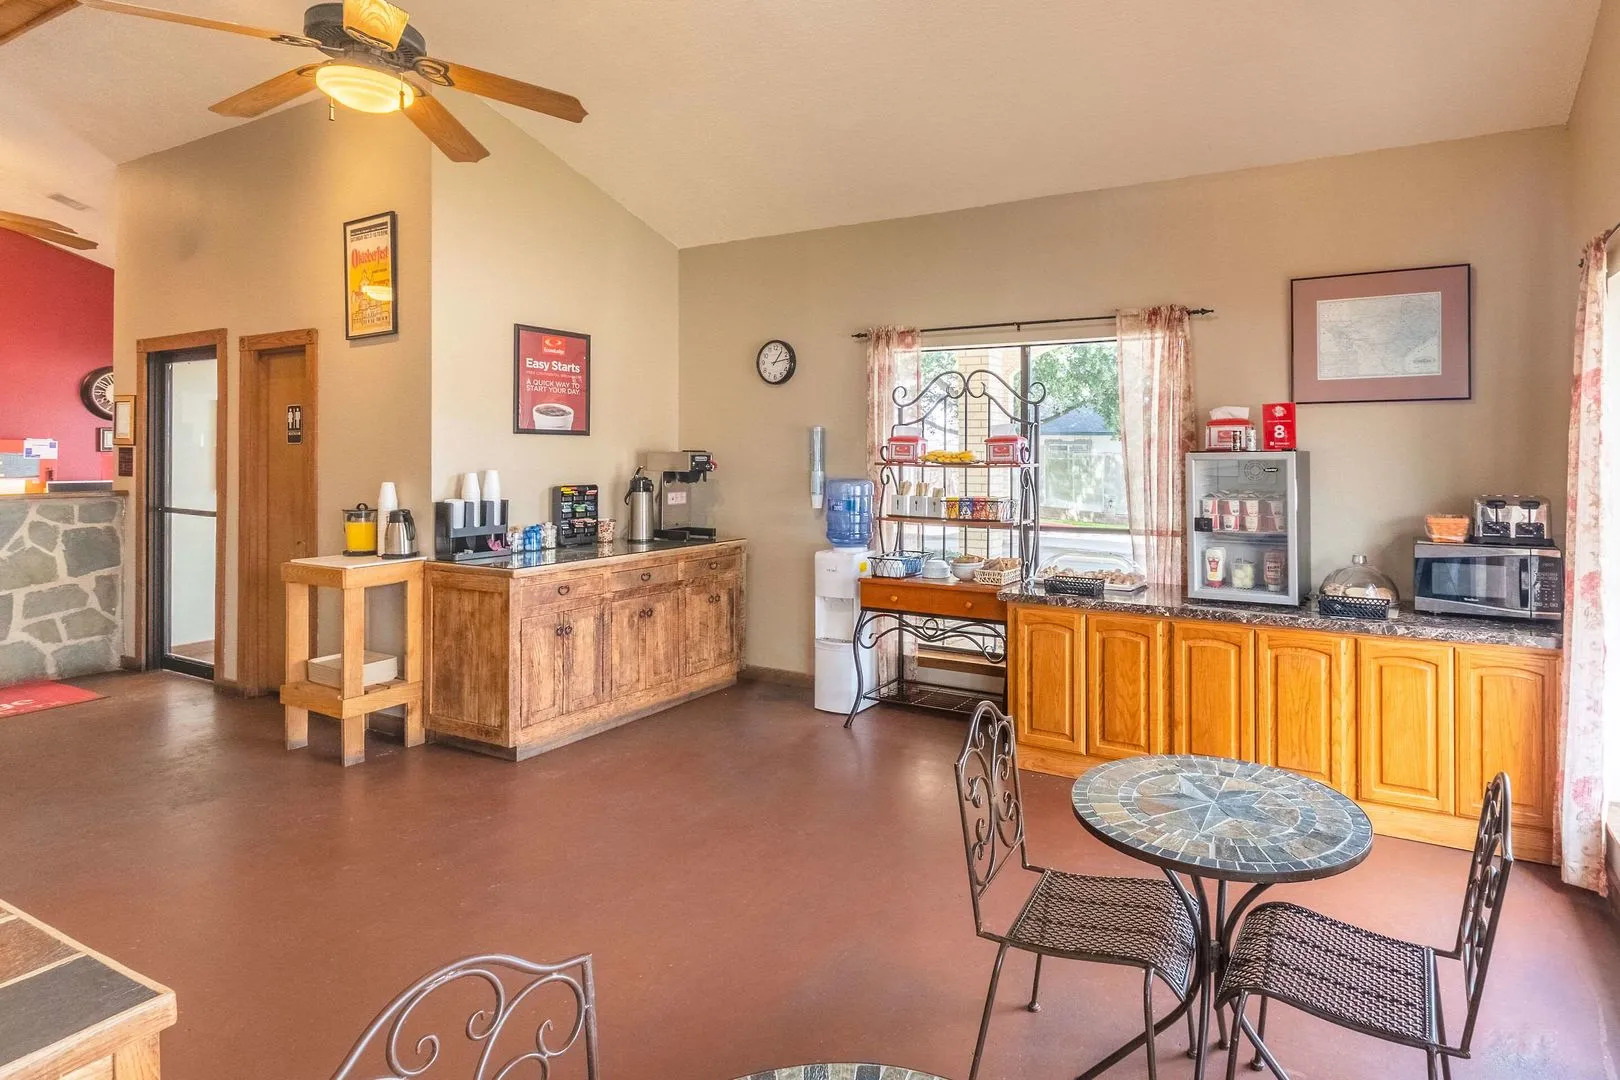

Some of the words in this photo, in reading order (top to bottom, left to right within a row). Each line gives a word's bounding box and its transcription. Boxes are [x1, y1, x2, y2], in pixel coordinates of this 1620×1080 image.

[352, 246, 388, 268] Oktoberfest
[526, 358, 550, 372] Easy
[552, 360, 580, 373] Starts
[1274, 425, 1285, 438] 8
